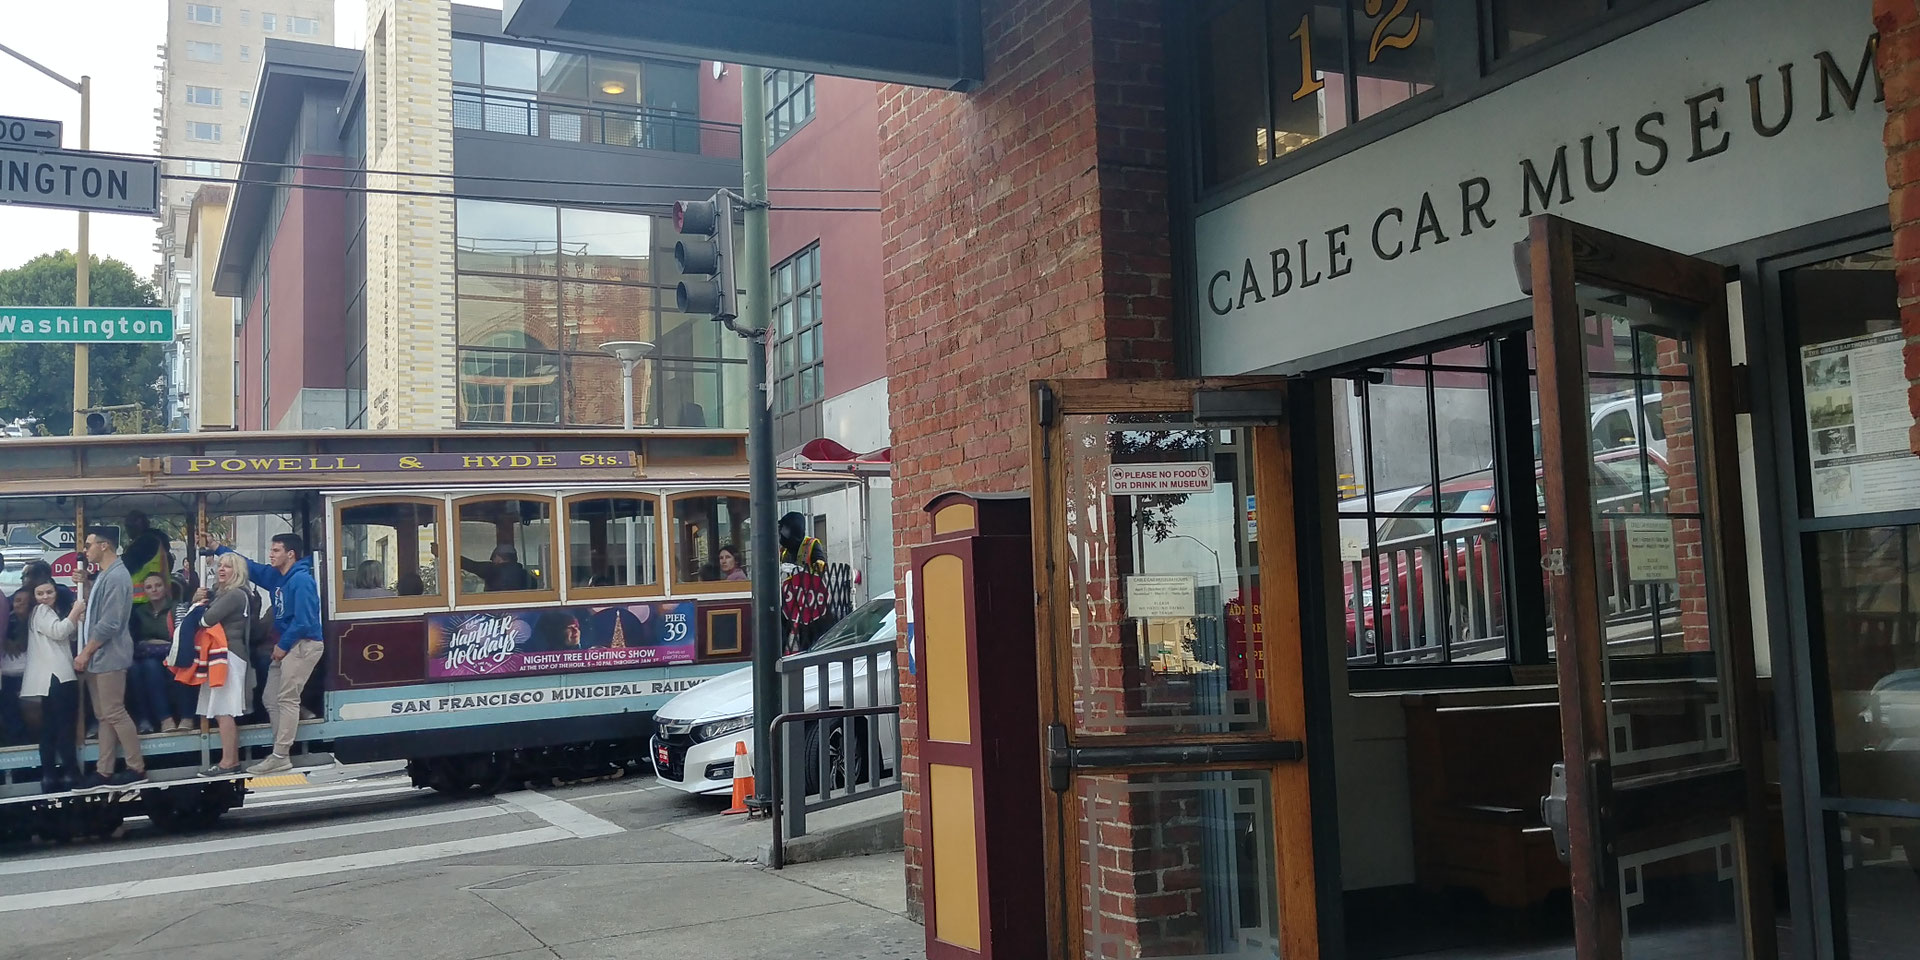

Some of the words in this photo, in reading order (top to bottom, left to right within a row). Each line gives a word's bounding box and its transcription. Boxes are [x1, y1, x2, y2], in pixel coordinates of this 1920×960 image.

[1207, 223, 1353, 316] CABLE
[1371, 176, 1497, 261] CAR
[1518, 32, 1886, 218] MUSEUM
[0, 315, 163, 340] Washington
[188, 457, 361, 472] POWELL
[399, 456, 424, 469] &
[462, 454, 557, 468] HYDE
[580, 453, 623, 466] Sts.
[1125, 471, 1157, 479] PLEASE
[1159, 470, 1172, 478] NO
[1173, 470, 1197, 478] FOOD
[1114, 481, 1128, 489] OR
[1130, 481, 1157, 489] DRINK
[1170, 480, 1208, 488] MUSEUM
[61, 532, 76, 542] ON
[55, 563, 72, 573] DO
[665, 613, 687, 622] PIER
[663, 622, 688, 642] 39
[362, 643, 385, 662] 6
[445, 629, 519, 670] Holidays
[523, 653, 561, 665] NIGHTLY
[563, 652, 583, 662] TREE
[584, 650, 626, 661] LIGHTING
[628, 649, 656, 659] SHOW
[391, 699, 431, 714] SAN
[438, 690, 545, 710] FRANCISCO
[551, 683, 642, 701] MUNICIPAL
[651, 678, 711, 695] RAILW
